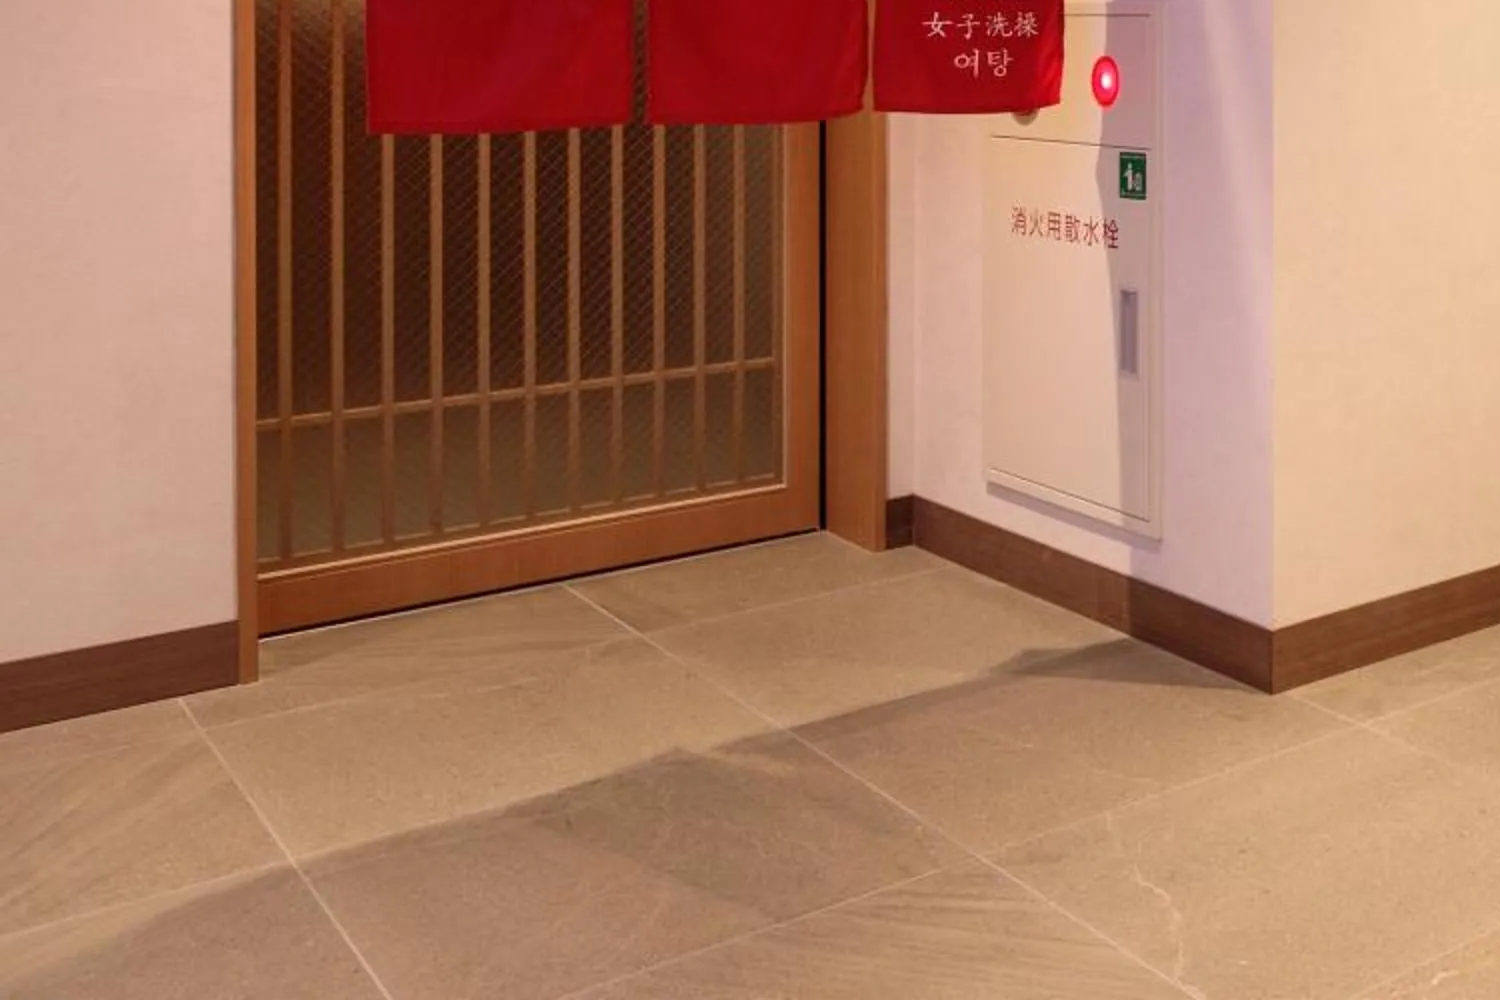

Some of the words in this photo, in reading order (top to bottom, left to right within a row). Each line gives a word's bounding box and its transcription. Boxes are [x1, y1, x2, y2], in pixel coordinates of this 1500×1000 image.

[953, 48, 1014, 78] 여탕
[1011, 205, 1119, 249] 消火用散水栓
